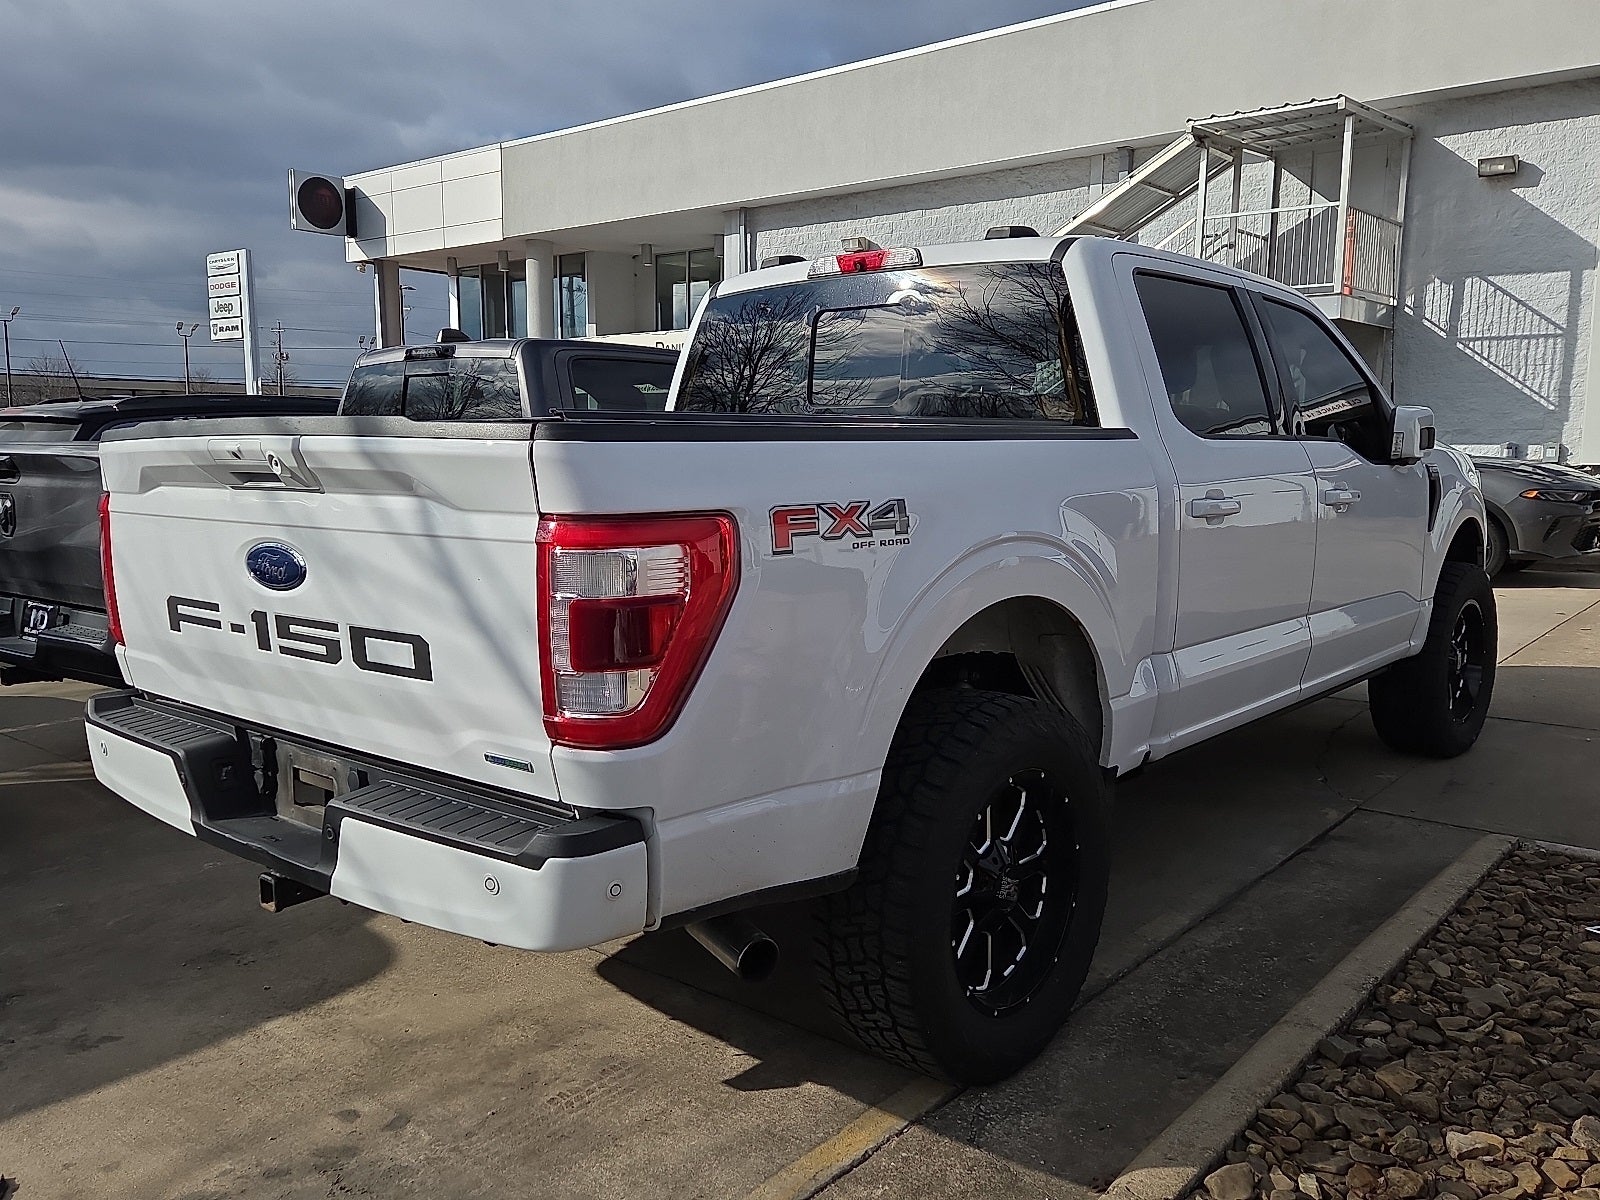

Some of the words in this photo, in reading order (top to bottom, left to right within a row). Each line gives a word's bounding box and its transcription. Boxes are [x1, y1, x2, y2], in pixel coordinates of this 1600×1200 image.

[209, 257, 235, 265] CHRYSLER
[210, 281, 237, 291] DODGE
[214, 301, 234, 314] Jeep
[219, 324, 239, 333] RAM
[769, 499, 910, 555] FX4
[852, 540, 876, 550] OFF
[879, 537, 911, 547] ROAD
[255, 552, 290, 582] Ford
[166, 595, 433, 682] F-150
